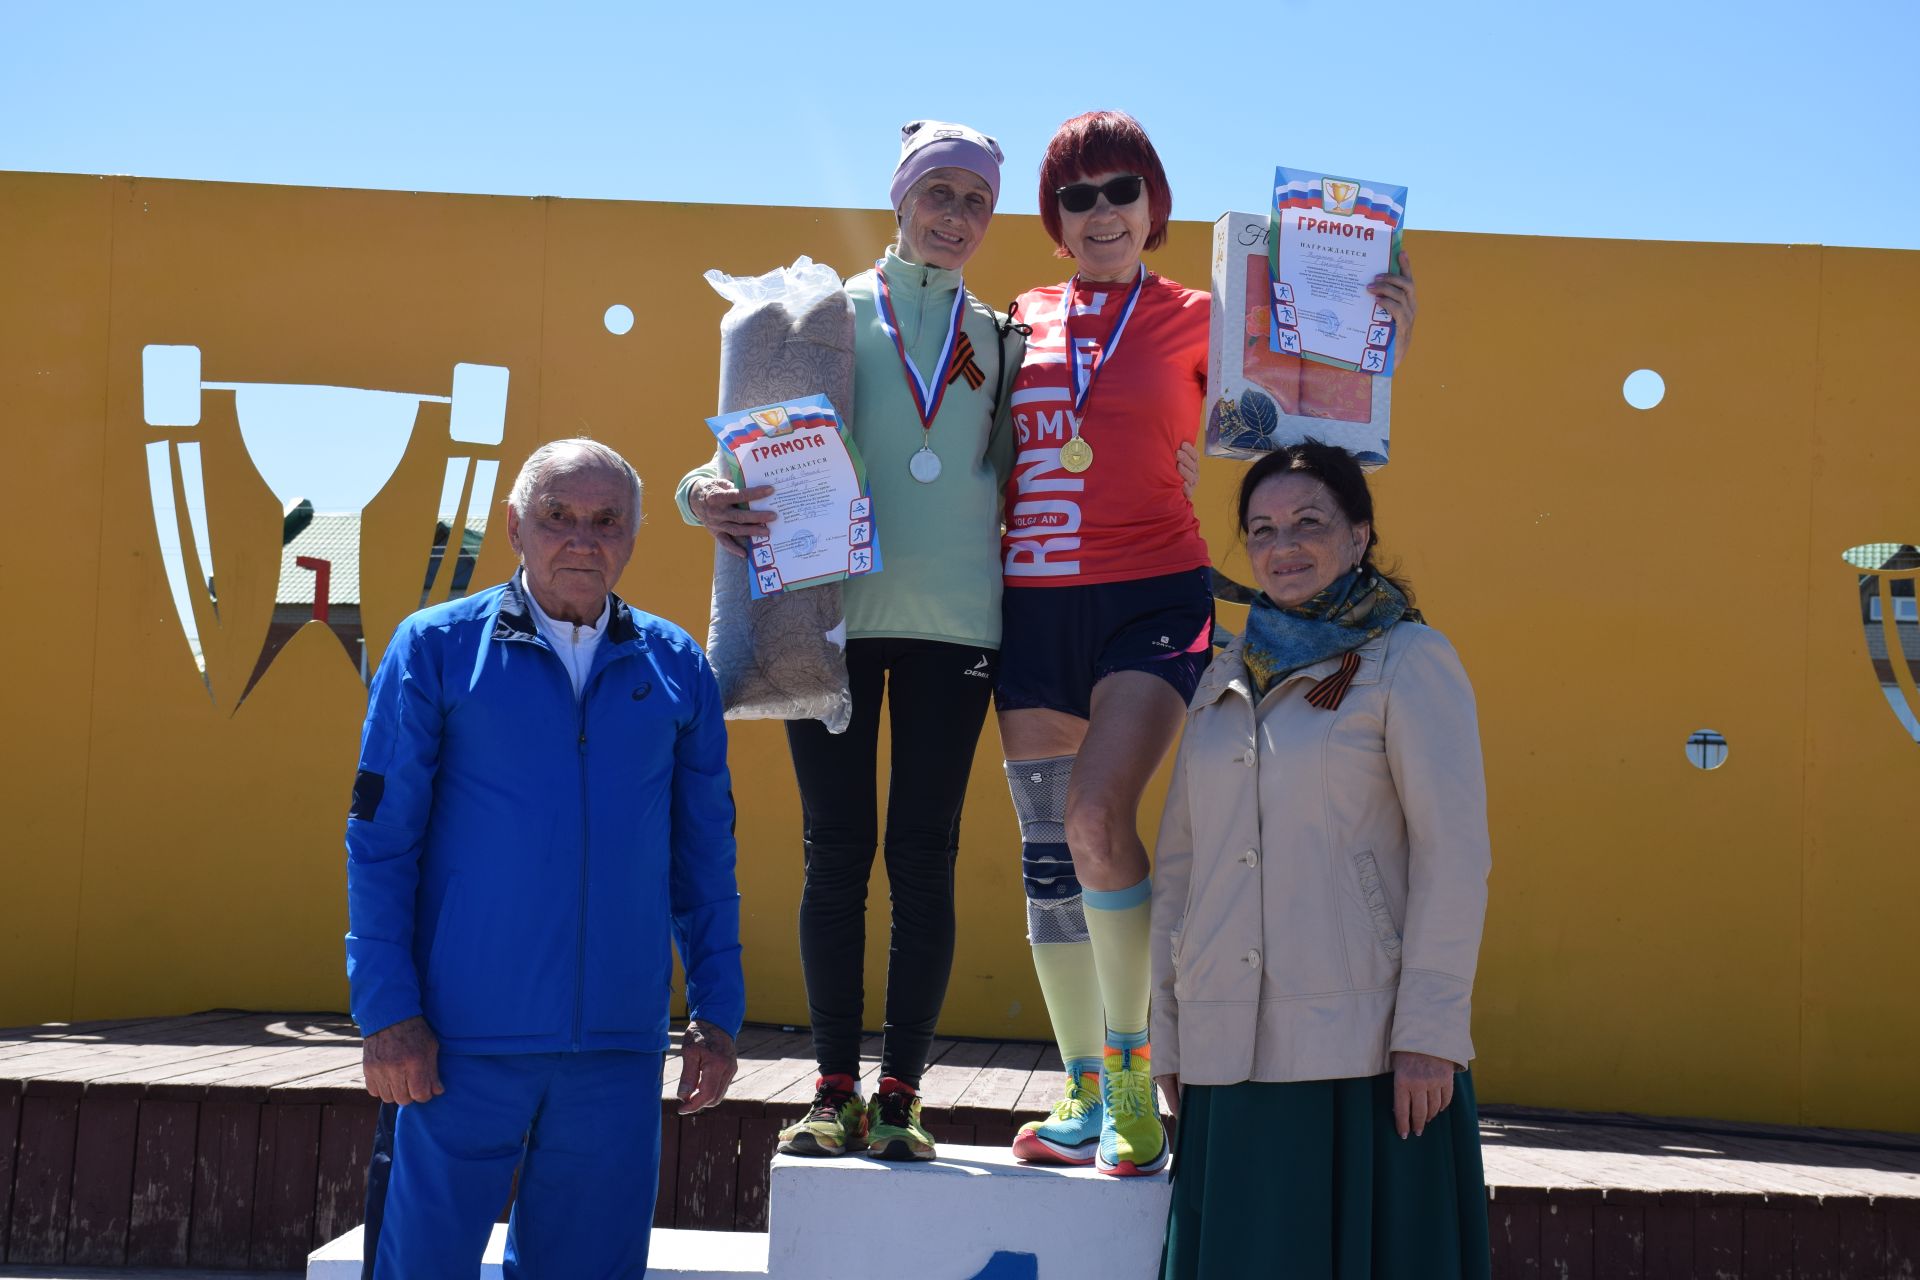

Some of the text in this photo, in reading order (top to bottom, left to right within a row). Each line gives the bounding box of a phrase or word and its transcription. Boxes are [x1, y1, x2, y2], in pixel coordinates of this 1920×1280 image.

[1237, 223, 1270, 247] Fl
[1297, 215, 1375, 241] ГРАМОТА
[1299, 242, 1368, 257] НАГРАЖДАЕТСЯ
[1013, 410, 1083, 446] IS MY
[751, 433, 826, 463] ГРАМОТА
[763, 457, 828, 478] НАГРАЖДАЕТСЯ
[1003, 447, 1085, 577] RUN
[963, 669, 990, 679] DEMIX
